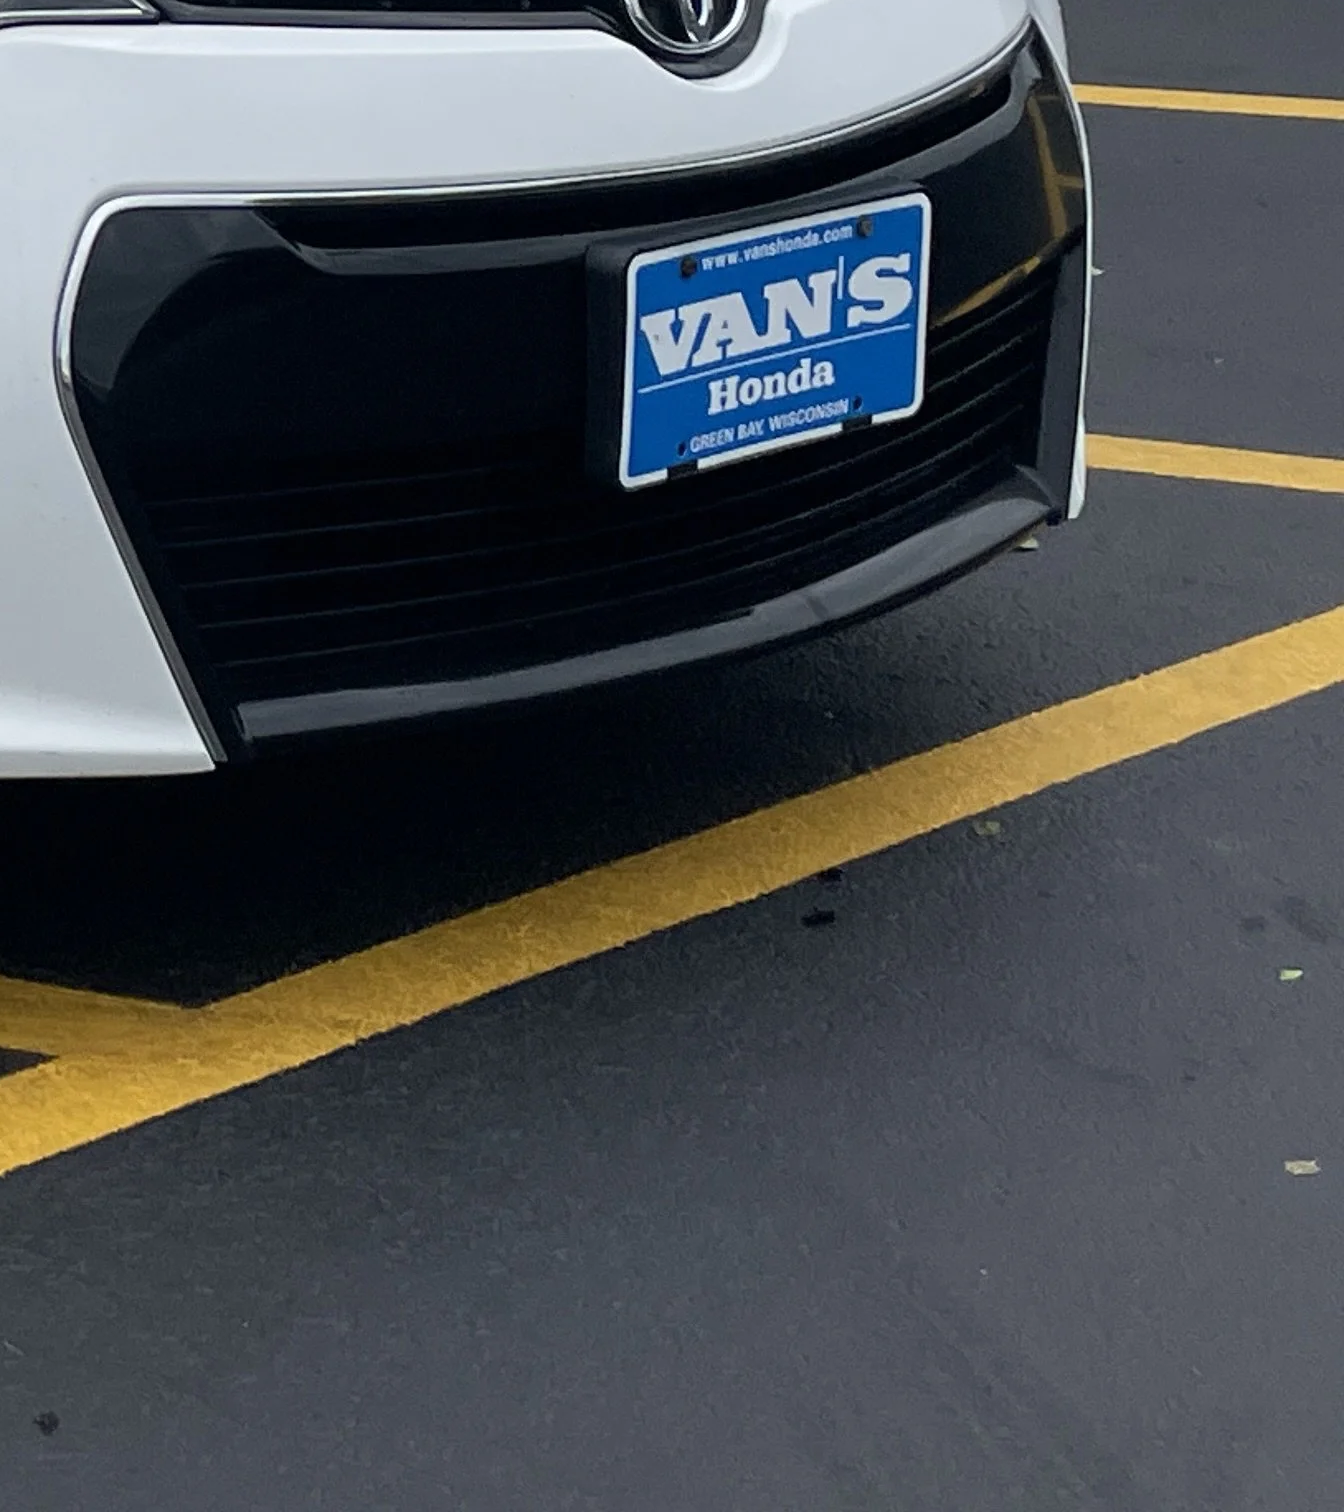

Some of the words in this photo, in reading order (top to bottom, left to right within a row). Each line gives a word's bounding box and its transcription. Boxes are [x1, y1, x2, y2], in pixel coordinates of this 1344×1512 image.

[701, 224, 853, 271] www.vanshonda.com
[639, 252, 913, 377] VAN'S
[707, 357, 835, 416] Honda
[689, 426, 736, 454] GREEN
[768, 397, 850, 432] WISCONSIN
